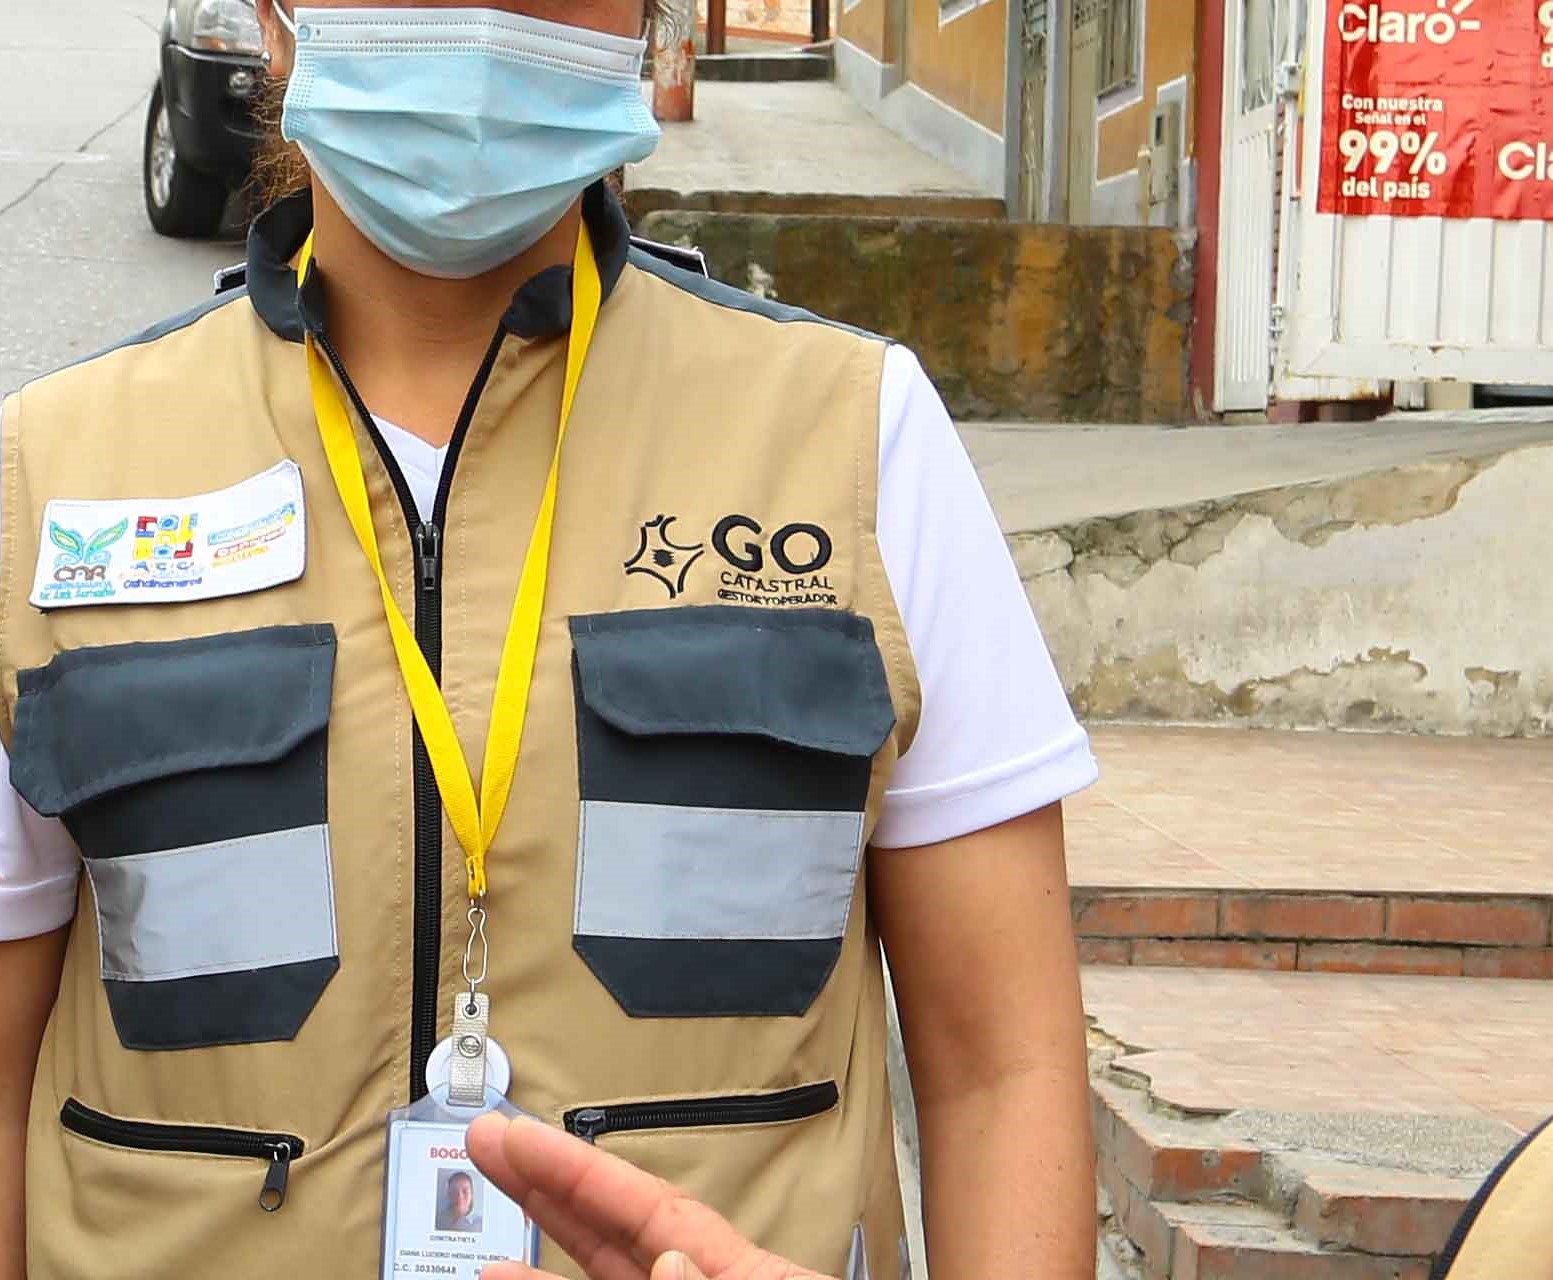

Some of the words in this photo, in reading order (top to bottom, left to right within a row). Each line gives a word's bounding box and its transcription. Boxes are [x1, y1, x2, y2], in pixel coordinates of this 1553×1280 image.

[1338, 2, 1457, 45] Claro
[1341, 93, 1374, 110] Con
[1377, 96, 1443, 112] nuestra
[1355, 111, 1393, 125] Señal
[1394, 114, 1411, 126] en
[1413, 113, 1427, 126] el
[1339, 129, 1447, 176] 99%
[1342, 176, 1379, 197] del
[1383, 176, 1431, 203] país
[711, 514, 833, 575] GO
[720, 571, 835, 593] CATASTRAL
